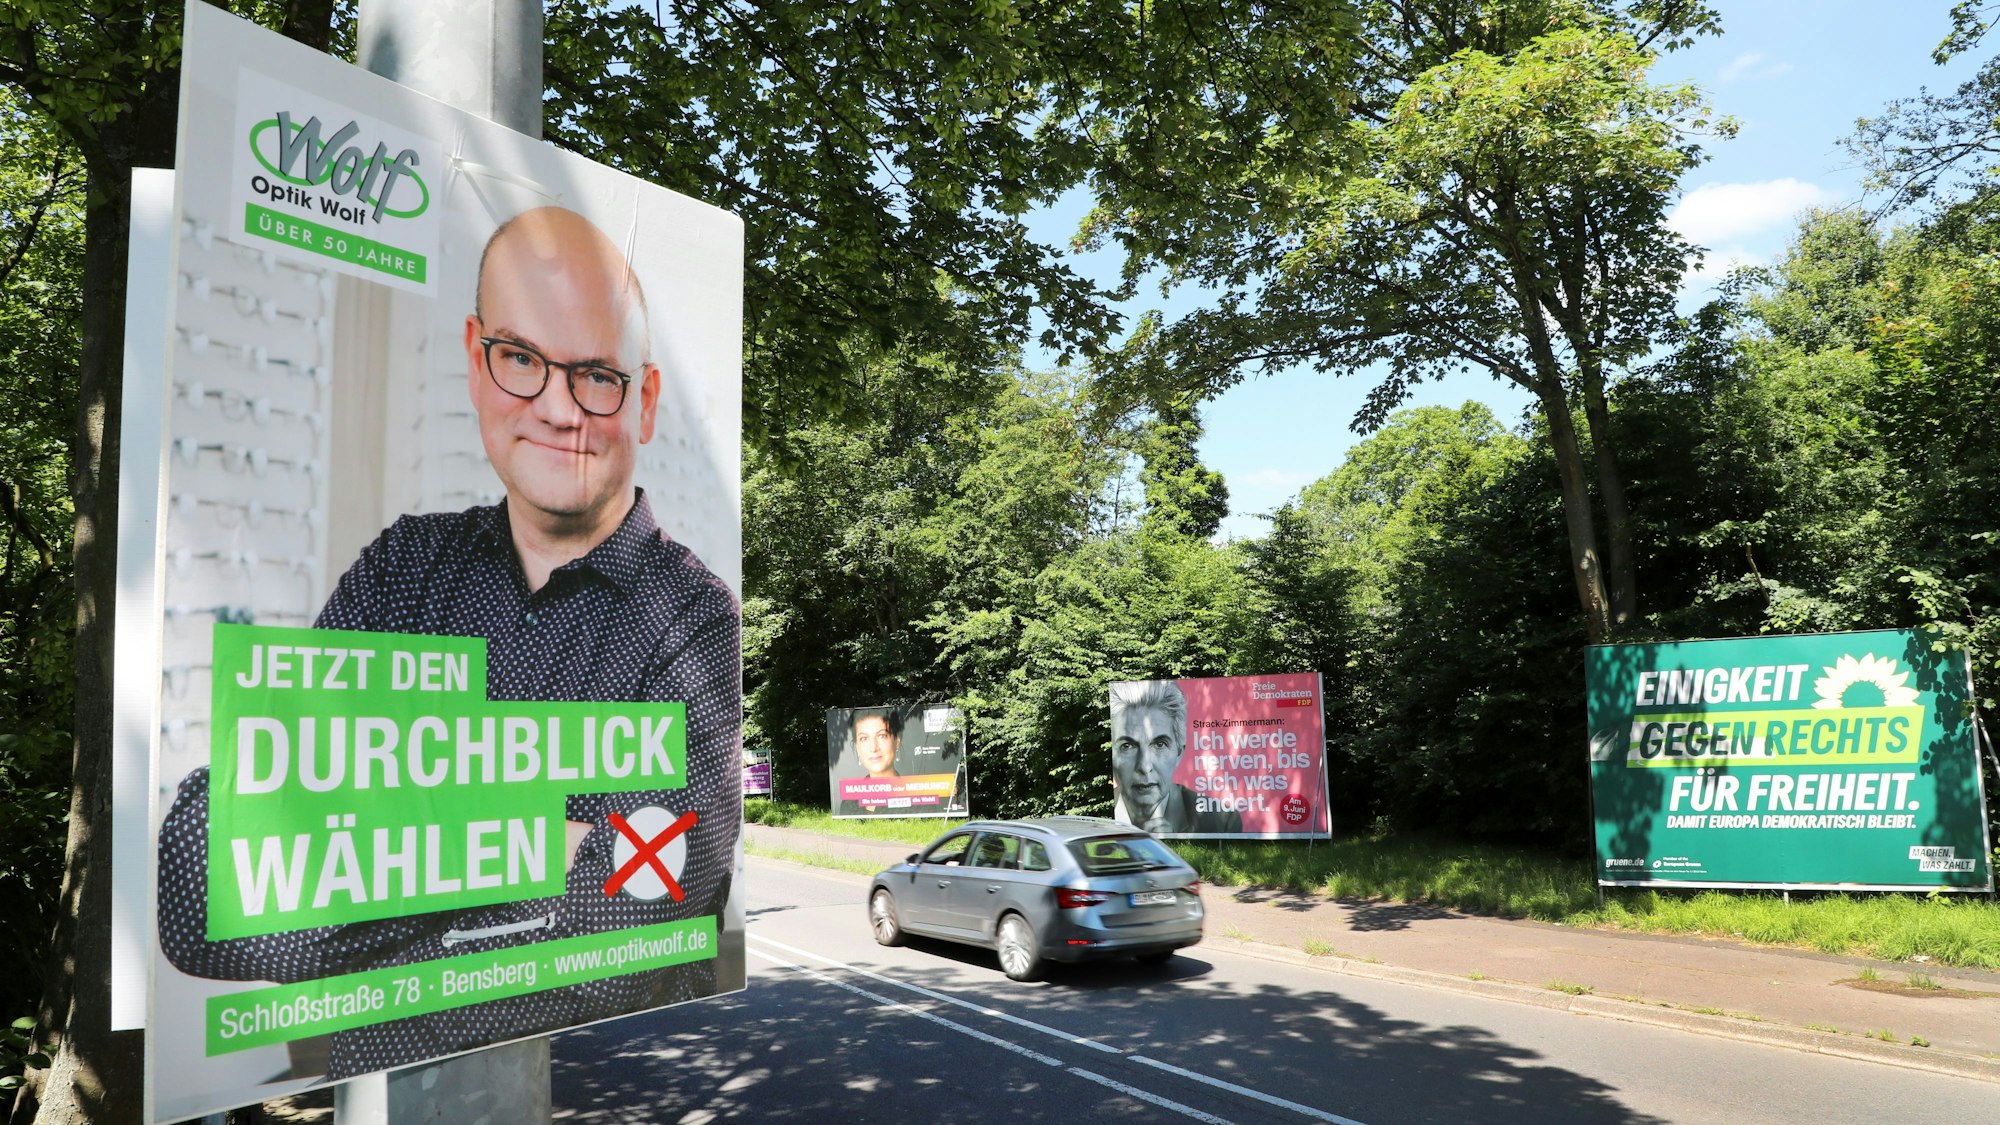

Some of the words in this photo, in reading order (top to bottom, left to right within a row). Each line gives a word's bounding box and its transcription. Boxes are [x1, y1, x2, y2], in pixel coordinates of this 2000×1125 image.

[277, 111, 420, 224] Wolf
[251, 175, 312, 209] Optik
[319, 196, 366, 226] Wolf
[258, 212, 313, 244] ÜBER
[323, 236, 348, 254] 50
[357, 246, 416, 275] JAHRE
[236, 645, 375, 688] JETZT
[392, 650, 469, 692] DEN
[1252, 682, 1276, 690] Freie
[1253, 690, 1312, 700] Demokraten
[1636, 665, 1808, 706] EINIGKEIT
[1193, 718, 1285, 728] Strack-Zimmermann:
[1193, 731, 1224, 750] Ich
[1230, 728, 1297, 749] werde
[1639, 721, 1757, 759] GEGEN
[1764, 716, 1909, 756] RECHTS
[236, 716, 675, 795] DURCHBLICK
[1194, 754, 1272, 772] nerven,
[1278, 749, 1310, 769] bis
[845, 784, 892, 793] MAULKORB
[1195, 772, 1238, 791] sich
[1243, 774, 1288, 791] was
[1669, 768, 1739, 811] FÜR
[1747, 773, 1920, 811] FREIHEIT.
[1195, 793, 1270, 812] ändert.
[1289, 797, 1301, 805] Am
[1290, 805, 1306, 813] Juni
[1287, 813, 1302, 821] FDP
[1666, 815, 1707, 829] DAMIT
[1709, 815, 1759, 828] EUROPA
[1762, 815, 1865, 829] DEMOKRATISCH
[1867, 815, 1917, 828] BLEIBT.
[1912, 848, 1951, 857] MACHEN,
[231, 814, 547, 917] WÄHLEN
[1605, 858, 1645, 868] gruene.de
[1922, 861, 1942, 869] WAS
[219, 985, 385, 1039] Schloßstraße
[392, 976, 421, 1006] 78
[442, 960, 537, 997] Bensberg
[554, 928, 707, 975] www.optikwolf.de
